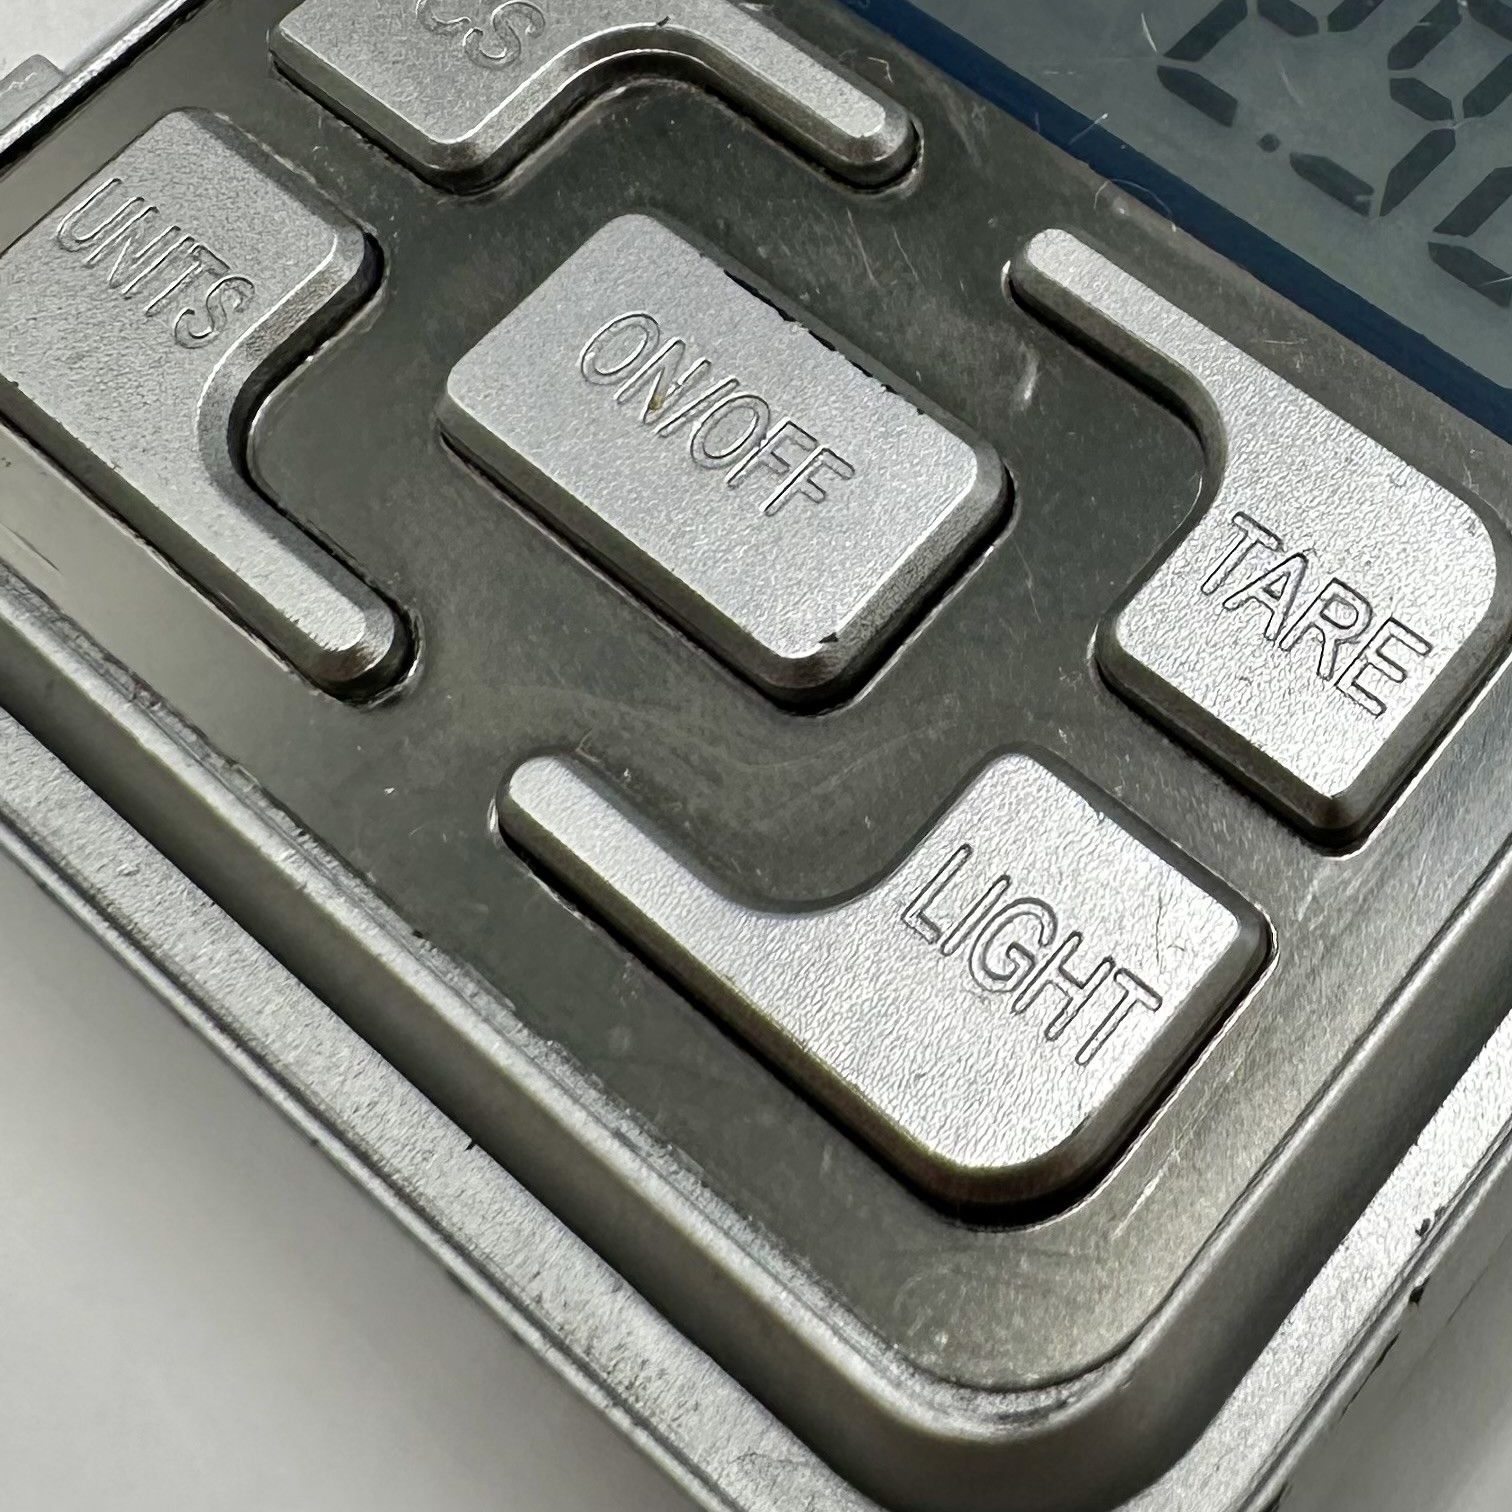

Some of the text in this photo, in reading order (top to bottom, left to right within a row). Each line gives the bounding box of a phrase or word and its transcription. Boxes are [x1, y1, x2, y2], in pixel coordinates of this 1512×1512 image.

[54, 176, 256, 349] UNITS
[578, 310, 856, 517] ON/OFF
[1199, 510, 1434, 717] TARE
[900, 844, 1163, 1066] LIGHT
